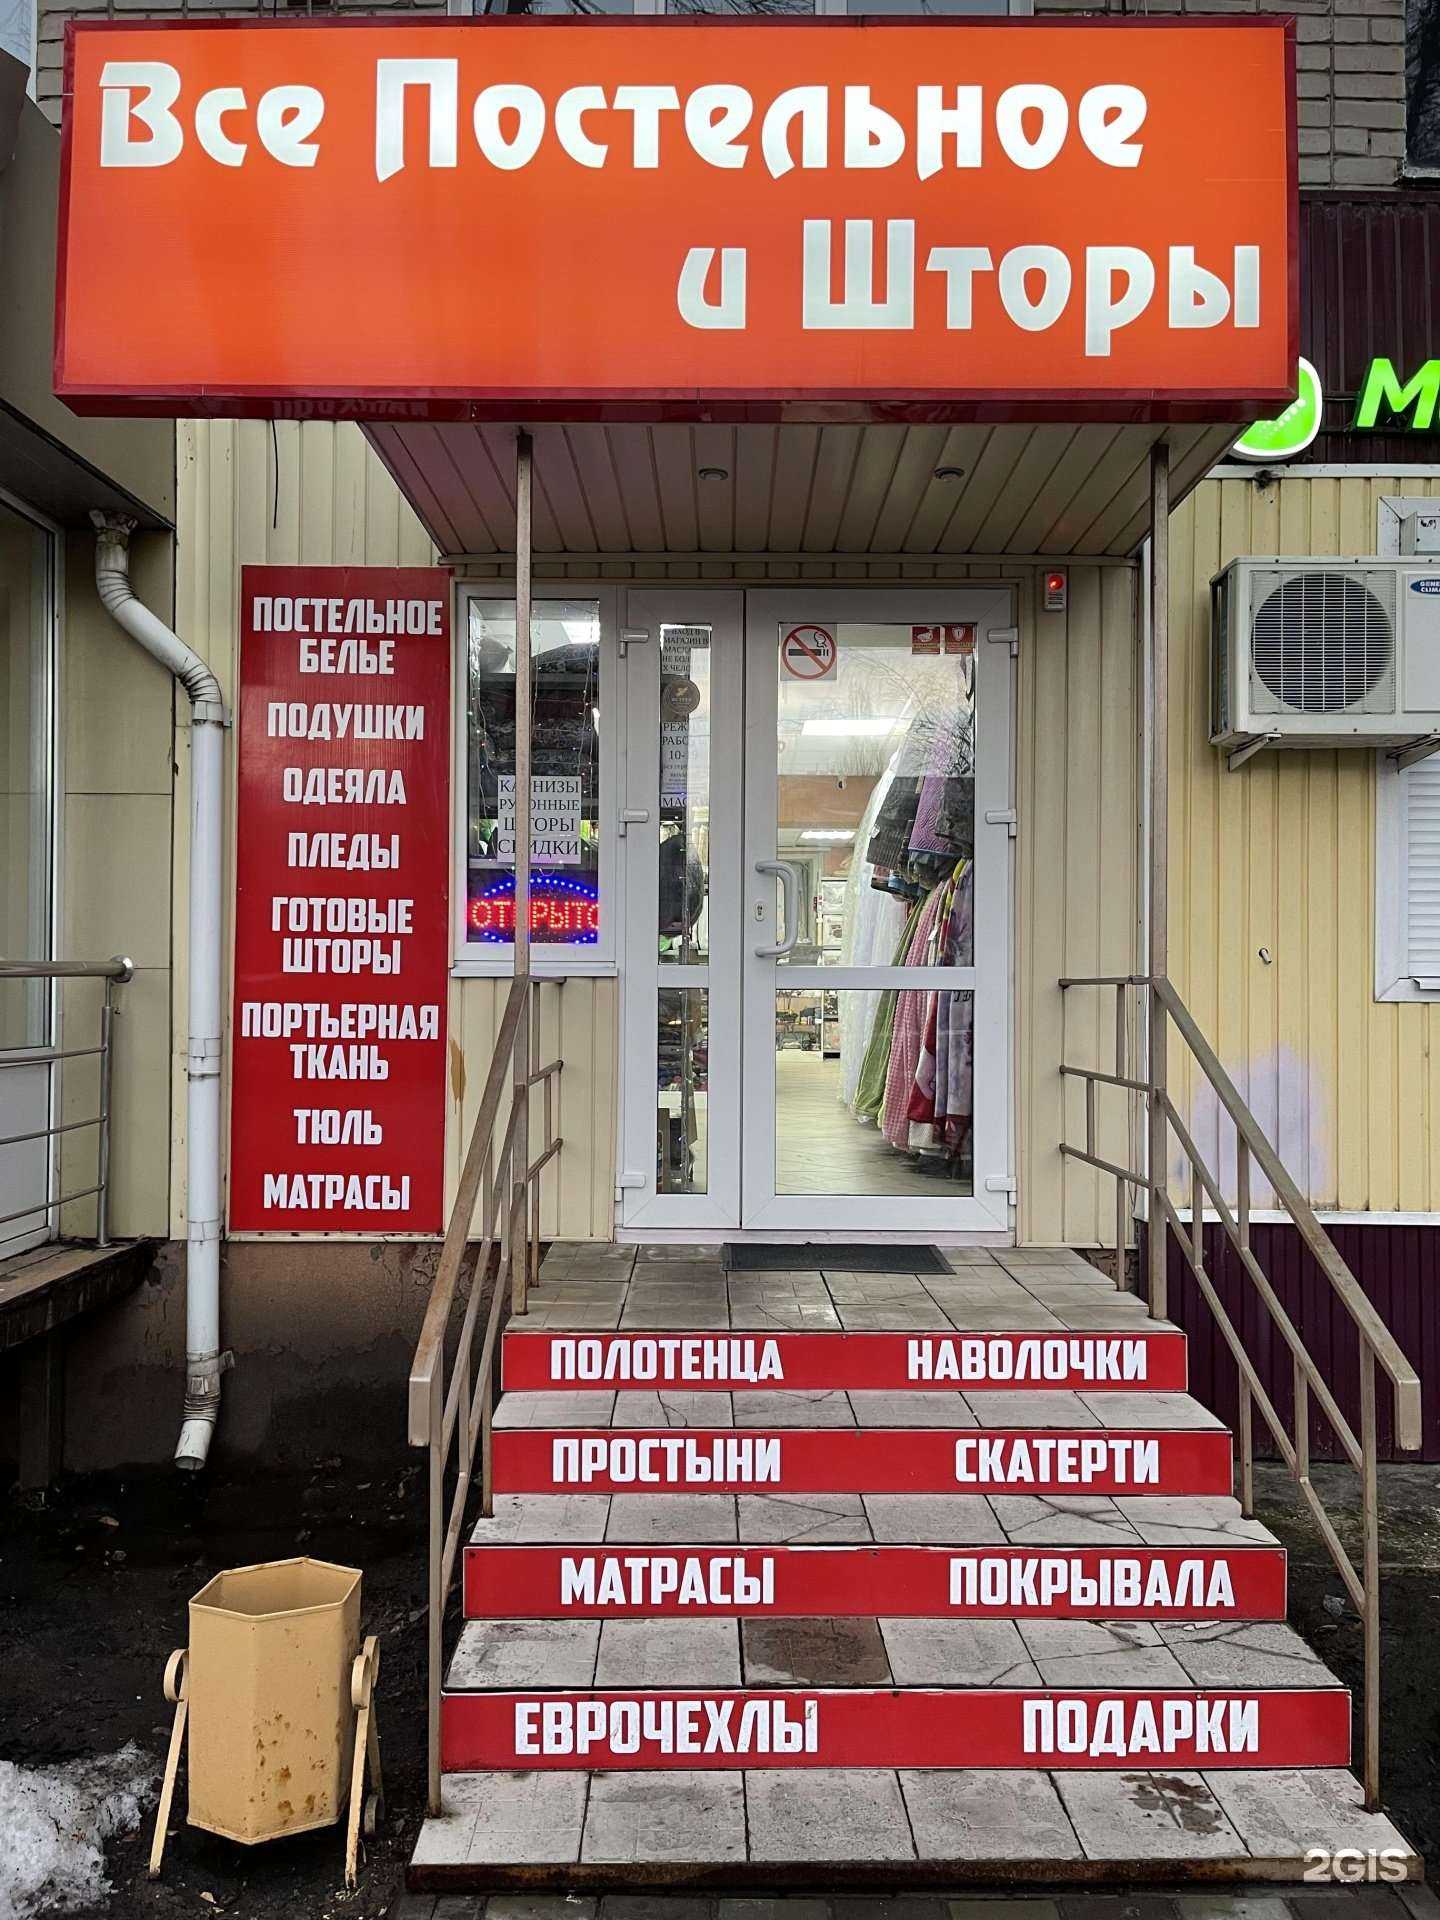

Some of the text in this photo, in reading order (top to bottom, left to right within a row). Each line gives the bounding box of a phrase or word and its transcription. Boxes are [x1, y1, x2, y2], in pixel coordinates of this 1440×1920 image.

[99, 58, 1147, 182] Все Постельное
[677, 219, 1259, 356] и Шторы
[1357, 358, 1440, 428] М
[254, 597, 442, 634] ПОСТЕЛЬНОЕ
[300, 639, 394, 674] БЕЛЬЕ
[268, 703, 424, 741] ПОДУШКИ
[663, 722, 688, 732] РЕЖ
[284, 768, 406, 805] ОДЕЯЛА
[499, 798, 580, 811] РУОННЫЕ
[500, 780, 579, 793] КНИЗЫ
[504, 817, 575, 832] ШОРЫ
[288, 833, 399, 870] ПЛЕДЫ
[272, 897, 413, 933] ГОТОВЫЕ
[472, 900, 599, 929] ОТРЫТО
[283, 938, 400, 974] ШТОРЫ
[242, 1003, 438, 1039] ПОРТЬЕРНАЯ
[290, 1044, 388, 1079] ТКАНЬ
[294, 1110, 382, 1144] ТЮЛЬ
[264, 1174, 409, 1210] МАТРАСЫ
[551, 1340, 1146, 1382] ПОЛОТЕНЦА НАВОЛОЧКИ
[553, 1439, 1159, 1483] ПРОСТЫНИ СКАТЕРТИ
[562, 1558, 1235, 1606] МАТРАСЫ ПОКРЫВАЛА
[516, 1700, 1258, 1756] ЕВРОЧЕХЛЫ ПОДАРКИ
